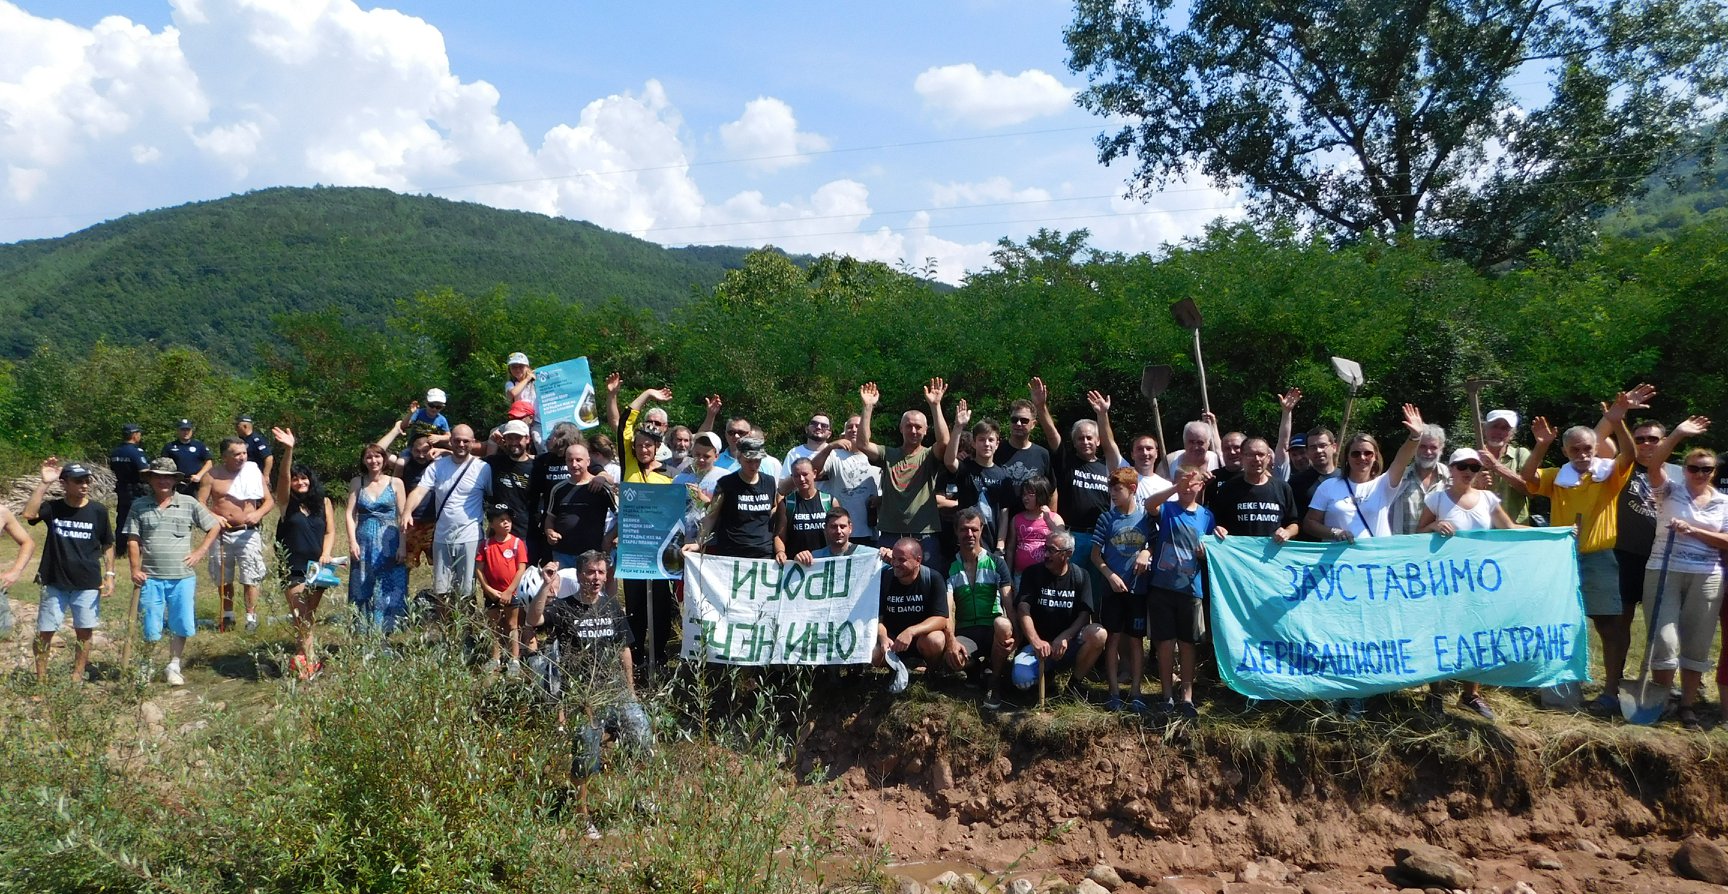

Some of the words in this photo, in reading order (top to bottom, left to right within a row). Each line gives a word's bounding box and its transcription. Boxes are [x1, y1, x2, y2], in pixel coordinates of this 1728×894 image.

[1075, 469, 1091, 480] REKE
[1091, 473, 1107, 483] VAM
[1237, 502, 1258, 510] REKE
[1259, 502, 1279, 511] VAM
[1249, 513, 1279, 523] DAMO!
[72, 520, 93, 530] VAM
[804, 522, 826, 530] DAMO
[1283, 558, 1502, 602] ЗАУСТАВИМО
[905, 594, 923, 602] VAM
[1057, 590, 1075, 598] VAM
[1037, 598, 1048, 606] NE
[897, 605, 924, 613] DAMO!
[783, 619, 857, 661] ОНИ
[1235, 639, 1417, 677] ДЕРИВАЦИОНЕ
[1434, 623, 1575, 672] ЕЛЕКТРАНЕ
